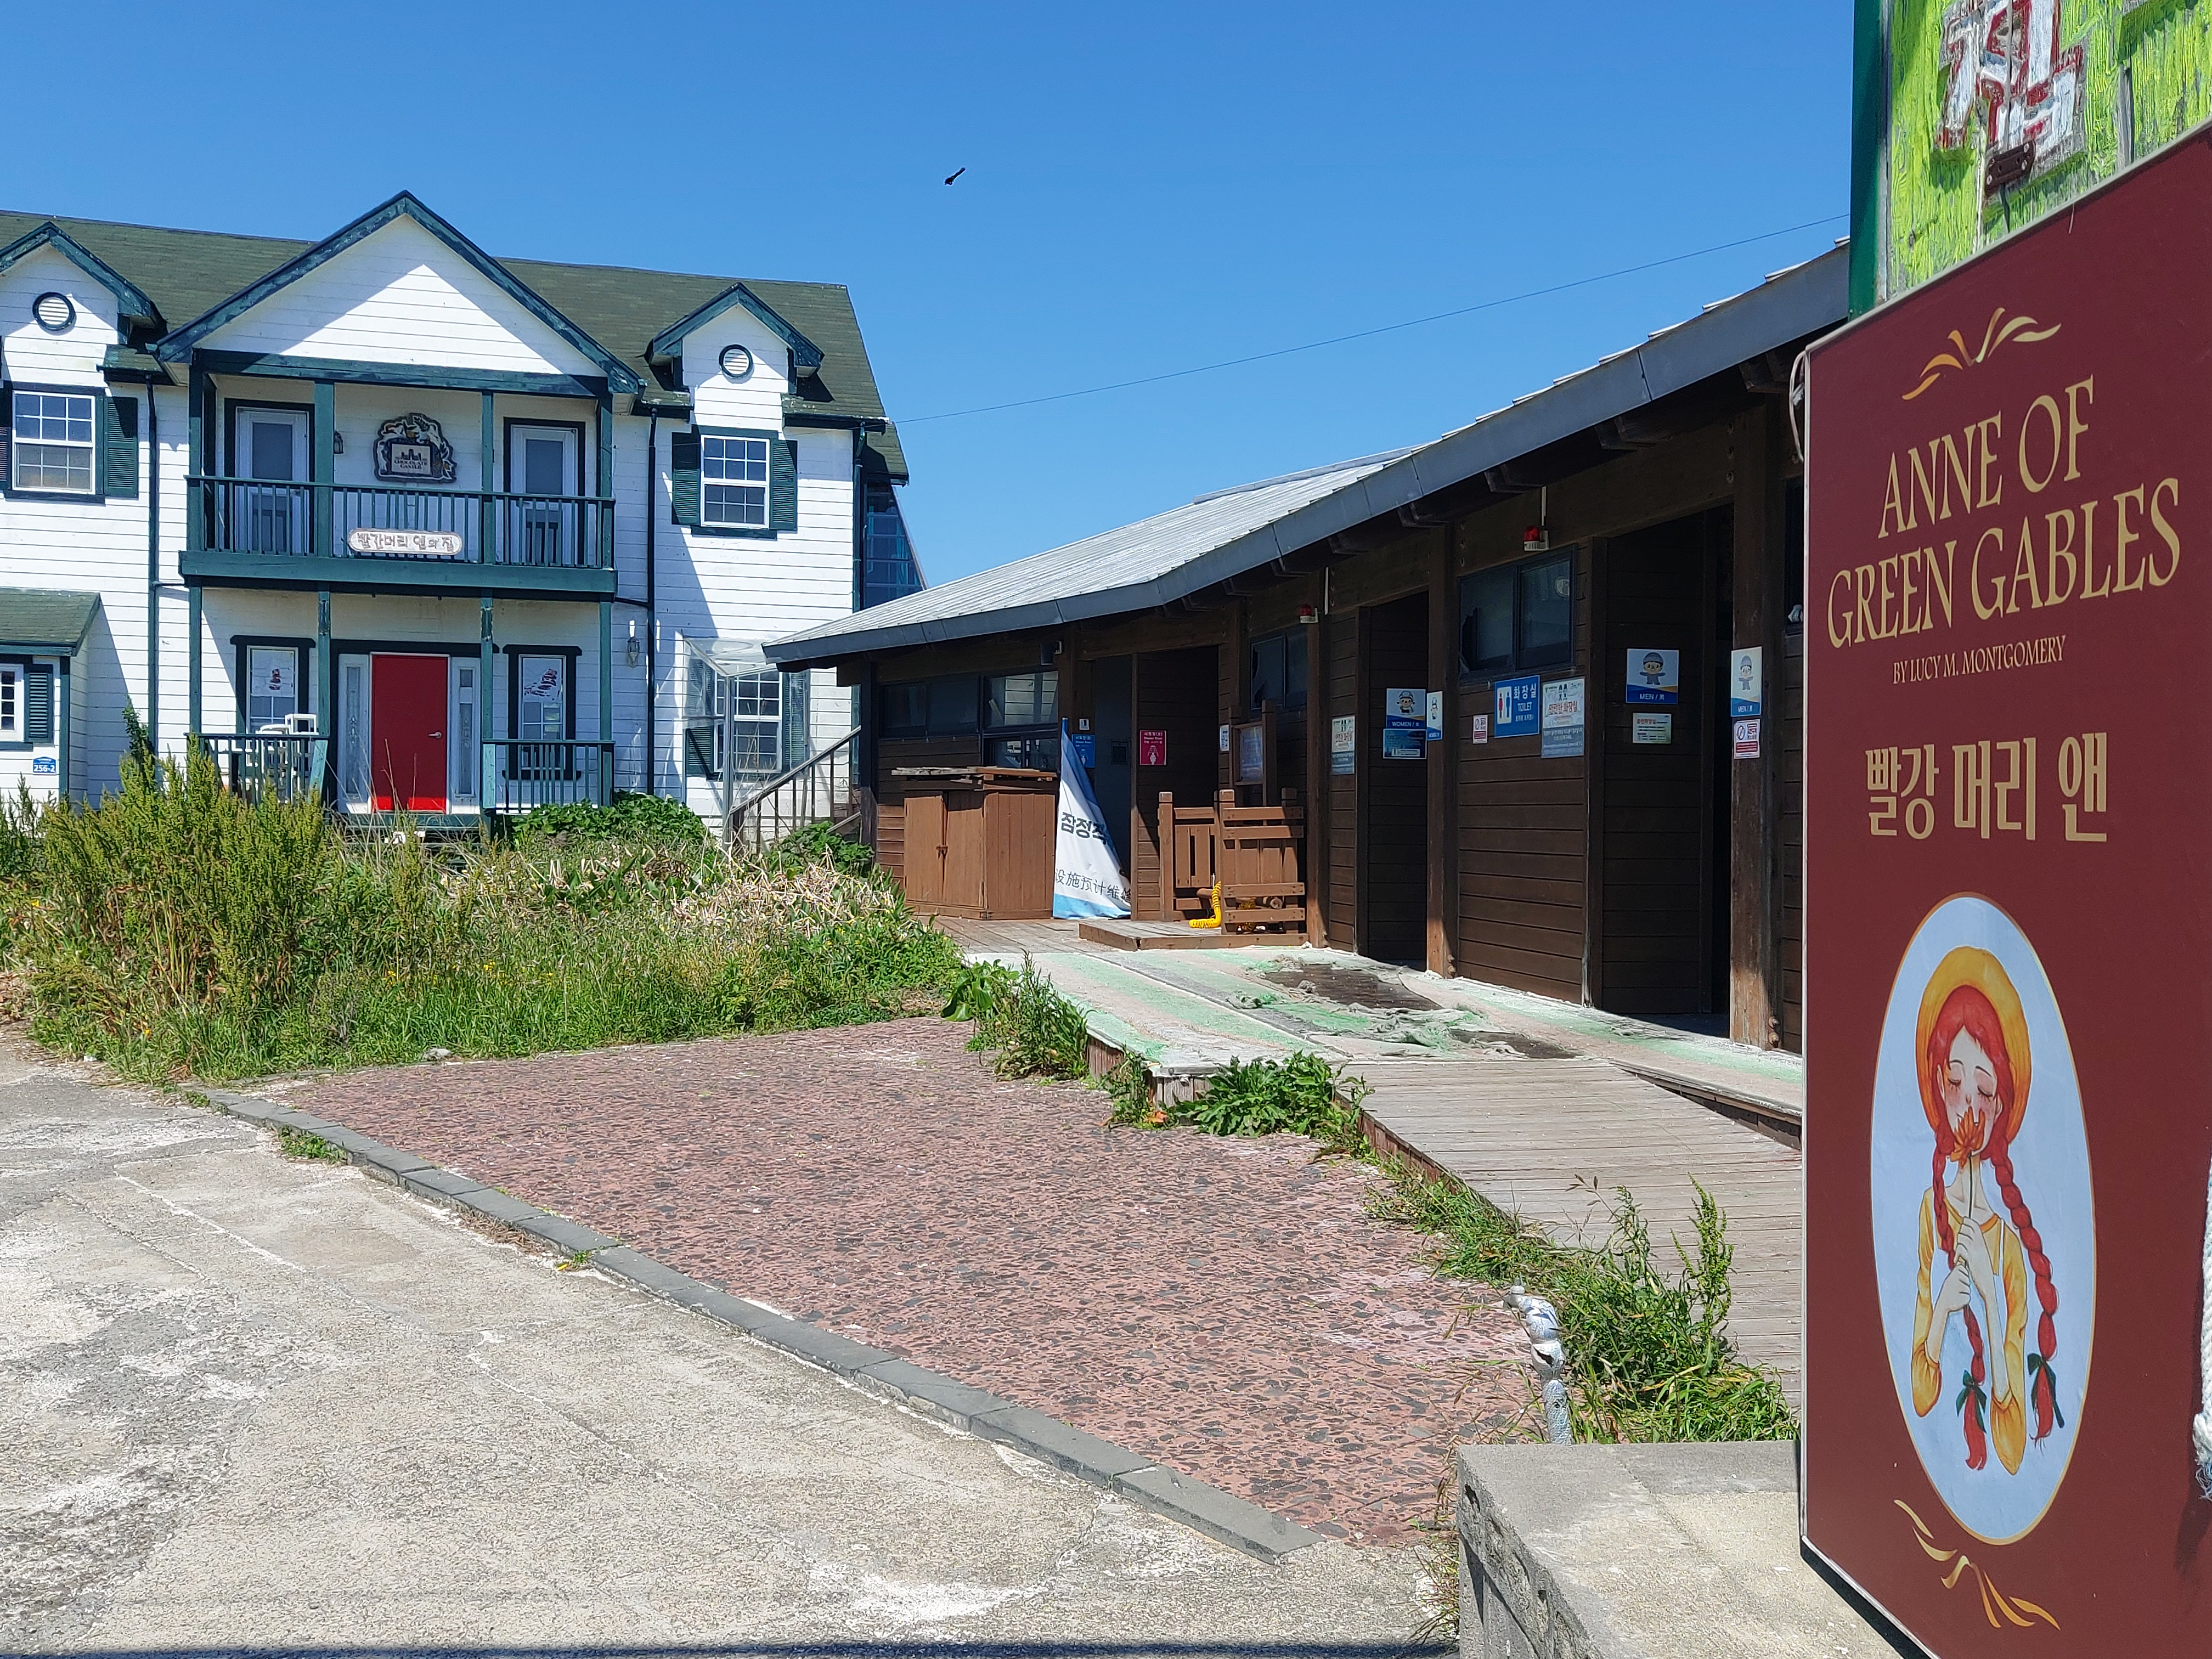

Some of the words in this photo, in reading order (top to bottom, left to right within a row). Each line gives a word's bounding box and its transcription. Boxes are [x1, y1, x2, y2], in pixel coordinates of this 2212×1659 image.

[1878, 409, 2002, 539] ANNE
[2019, 371, 2094, 493] OF
[1827, 540, 1957, 648] GREEN
[1971, 478, 2181, 620] GABLES
[1893, 662, 1908, 684] BY
[1910, 655, 1941, 682] LUCY
[1943, 653, 1959, 678] M.
[1961, 635, 2066, 675] MONTGOMERY
[1513, 683, 1537, 700] 화장실
[1517, 702, 1533, 712] TOILET
[33, 764, 55, 772] 256-2
[1865, 744, 1940, 840] 빨강
[1952, 737, 2036, 840] 머리
[2058, 732, 2107, 842] 앤
